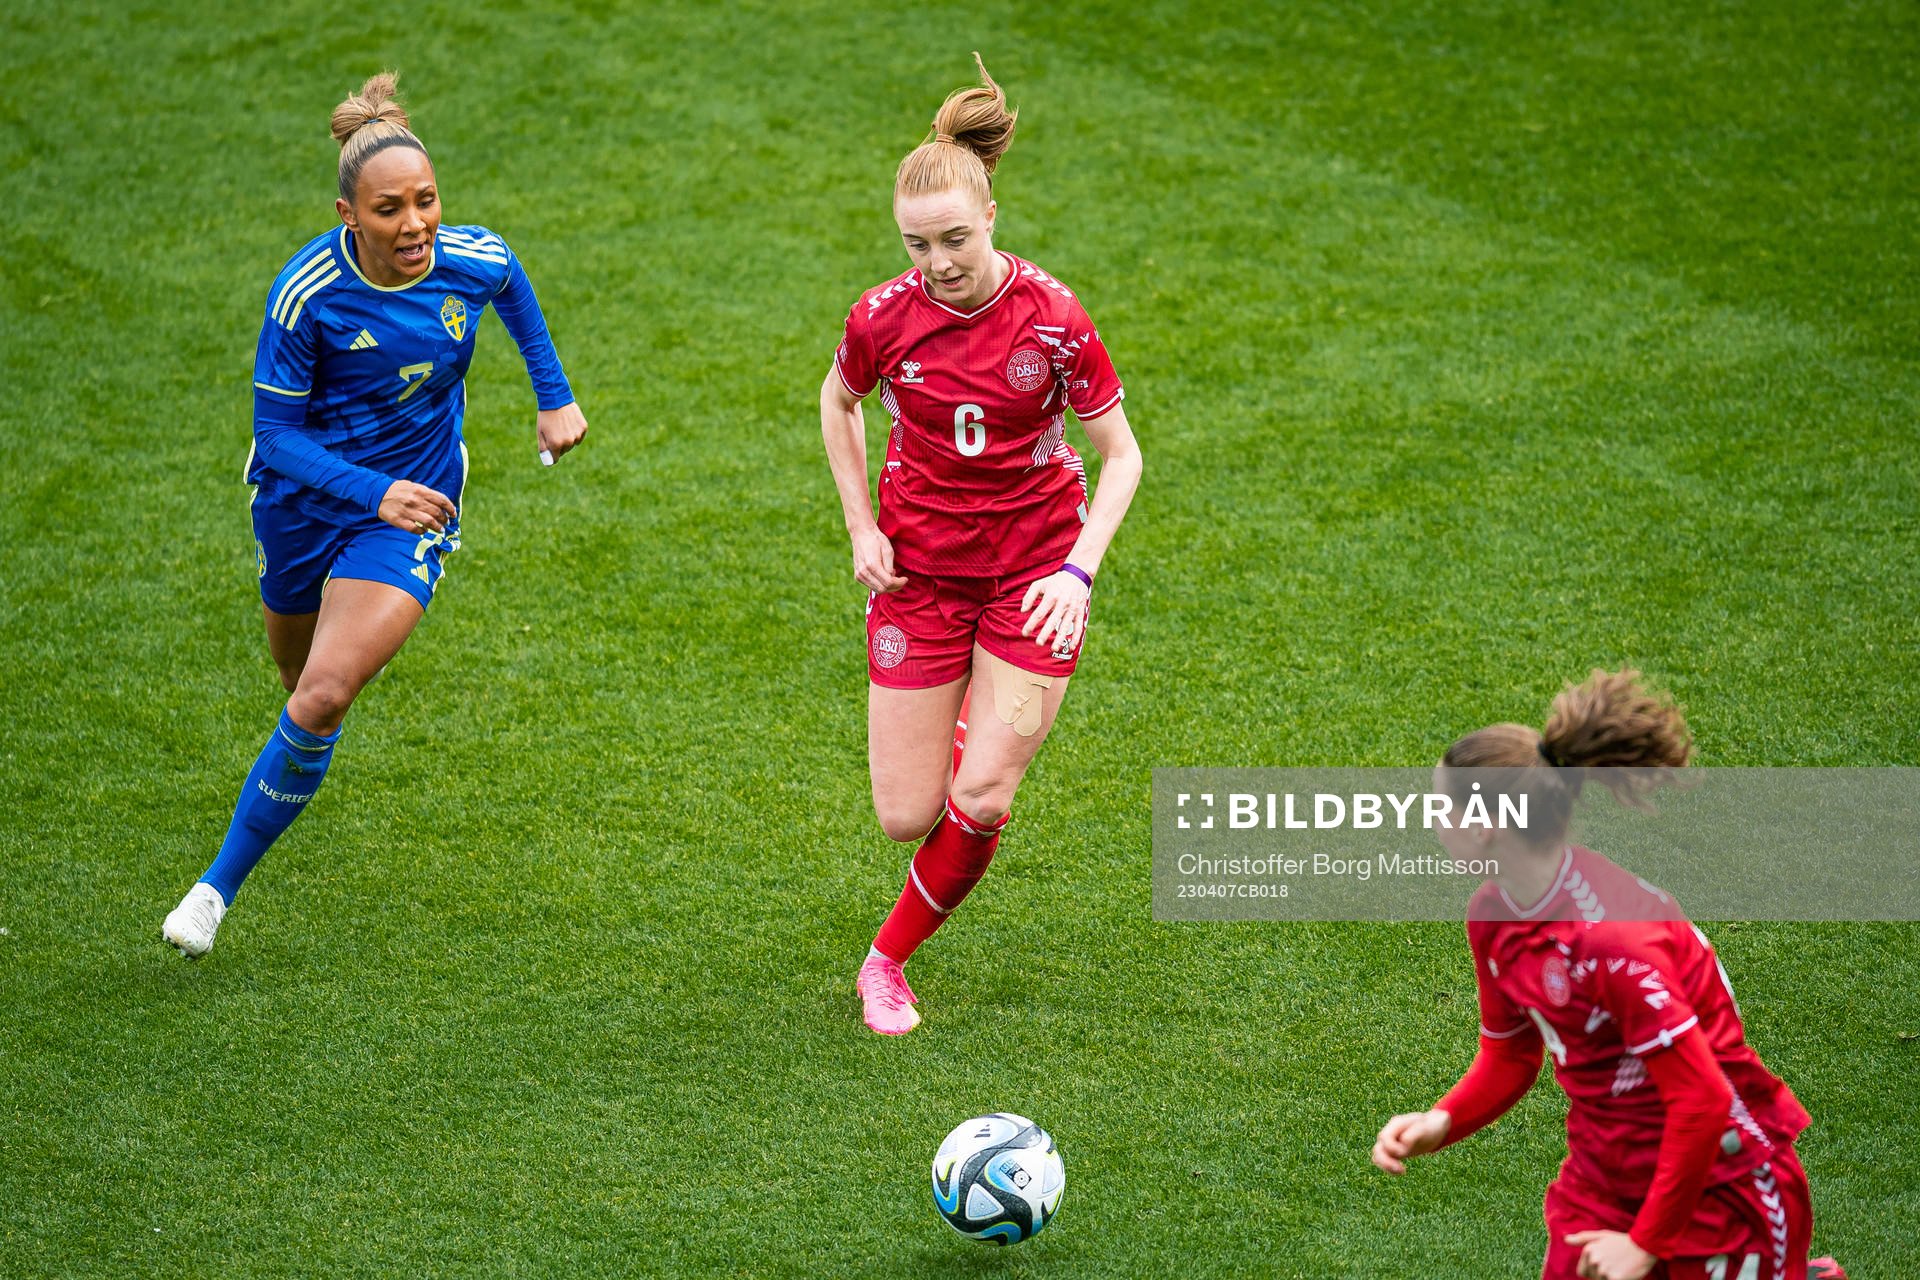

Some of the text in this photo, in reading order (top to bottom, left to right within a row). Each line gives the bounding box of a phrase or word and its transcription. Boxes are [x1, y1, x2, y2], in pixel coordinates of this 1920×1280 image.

[398, 362, 434, 403] 7
[1015, 363, 1040, 378] DBU
[954, 403, 986, 457] 6
[879, 638, 899, 654] DBU
